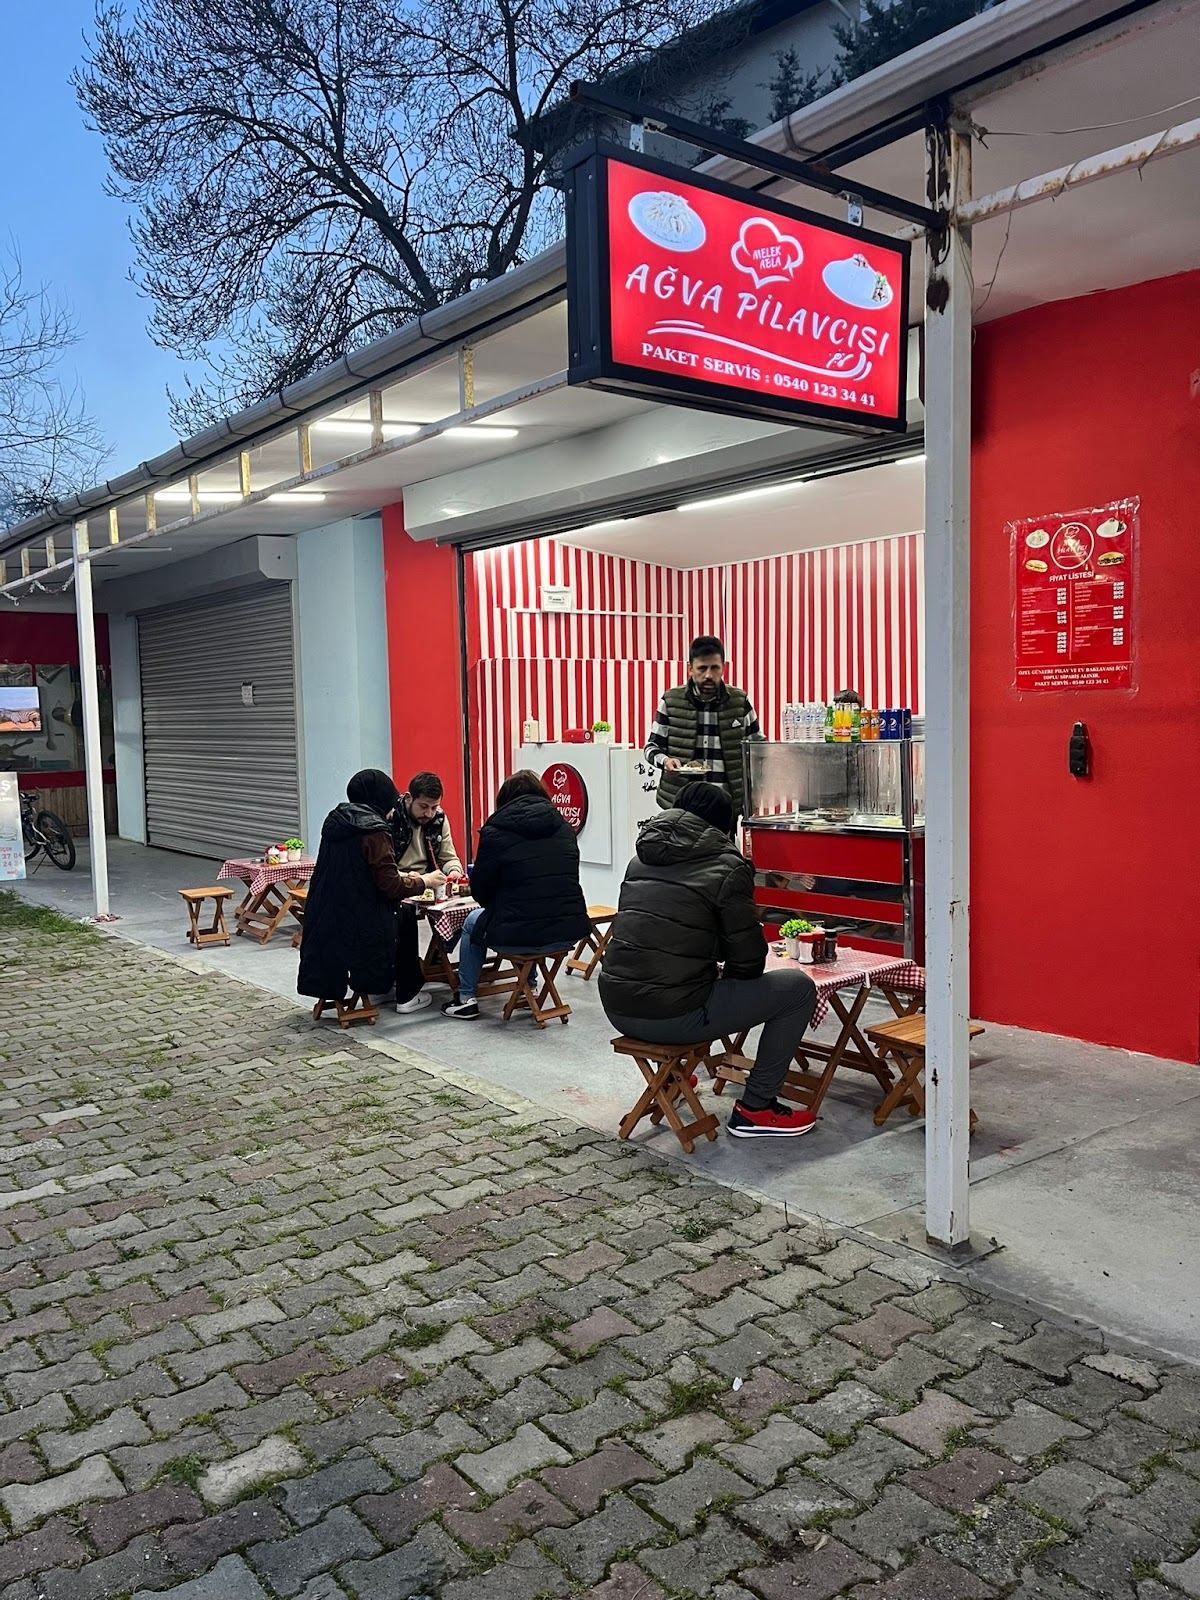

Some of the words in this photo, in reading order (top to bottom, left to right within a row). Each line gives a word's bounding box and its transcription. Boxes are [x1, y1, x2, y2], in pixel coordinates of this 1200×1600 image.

[753, 246, 781, 260] MELEK
[760, 256, 781, 269] ABLA
[625, 264, 723, 313] AĞVA
[737, 292, 889, 356] PİLAVCISI
[641, 343, 699, 367] PAKET
[703, 356, 760, 381] SERVİS
[774, 373, 809, 392] 0540
[814, 381, 837, 399] 123
[841, 388, 857, 403] 34
[860, 391, 875, 407] 41
[1049, 574, 1067, 582] FİYAT
[1068, 570, 1094, 580] LİSTESİ
[551, 793, 571, 804] AĞVA
[557, 807, 581, 816] VCISI
